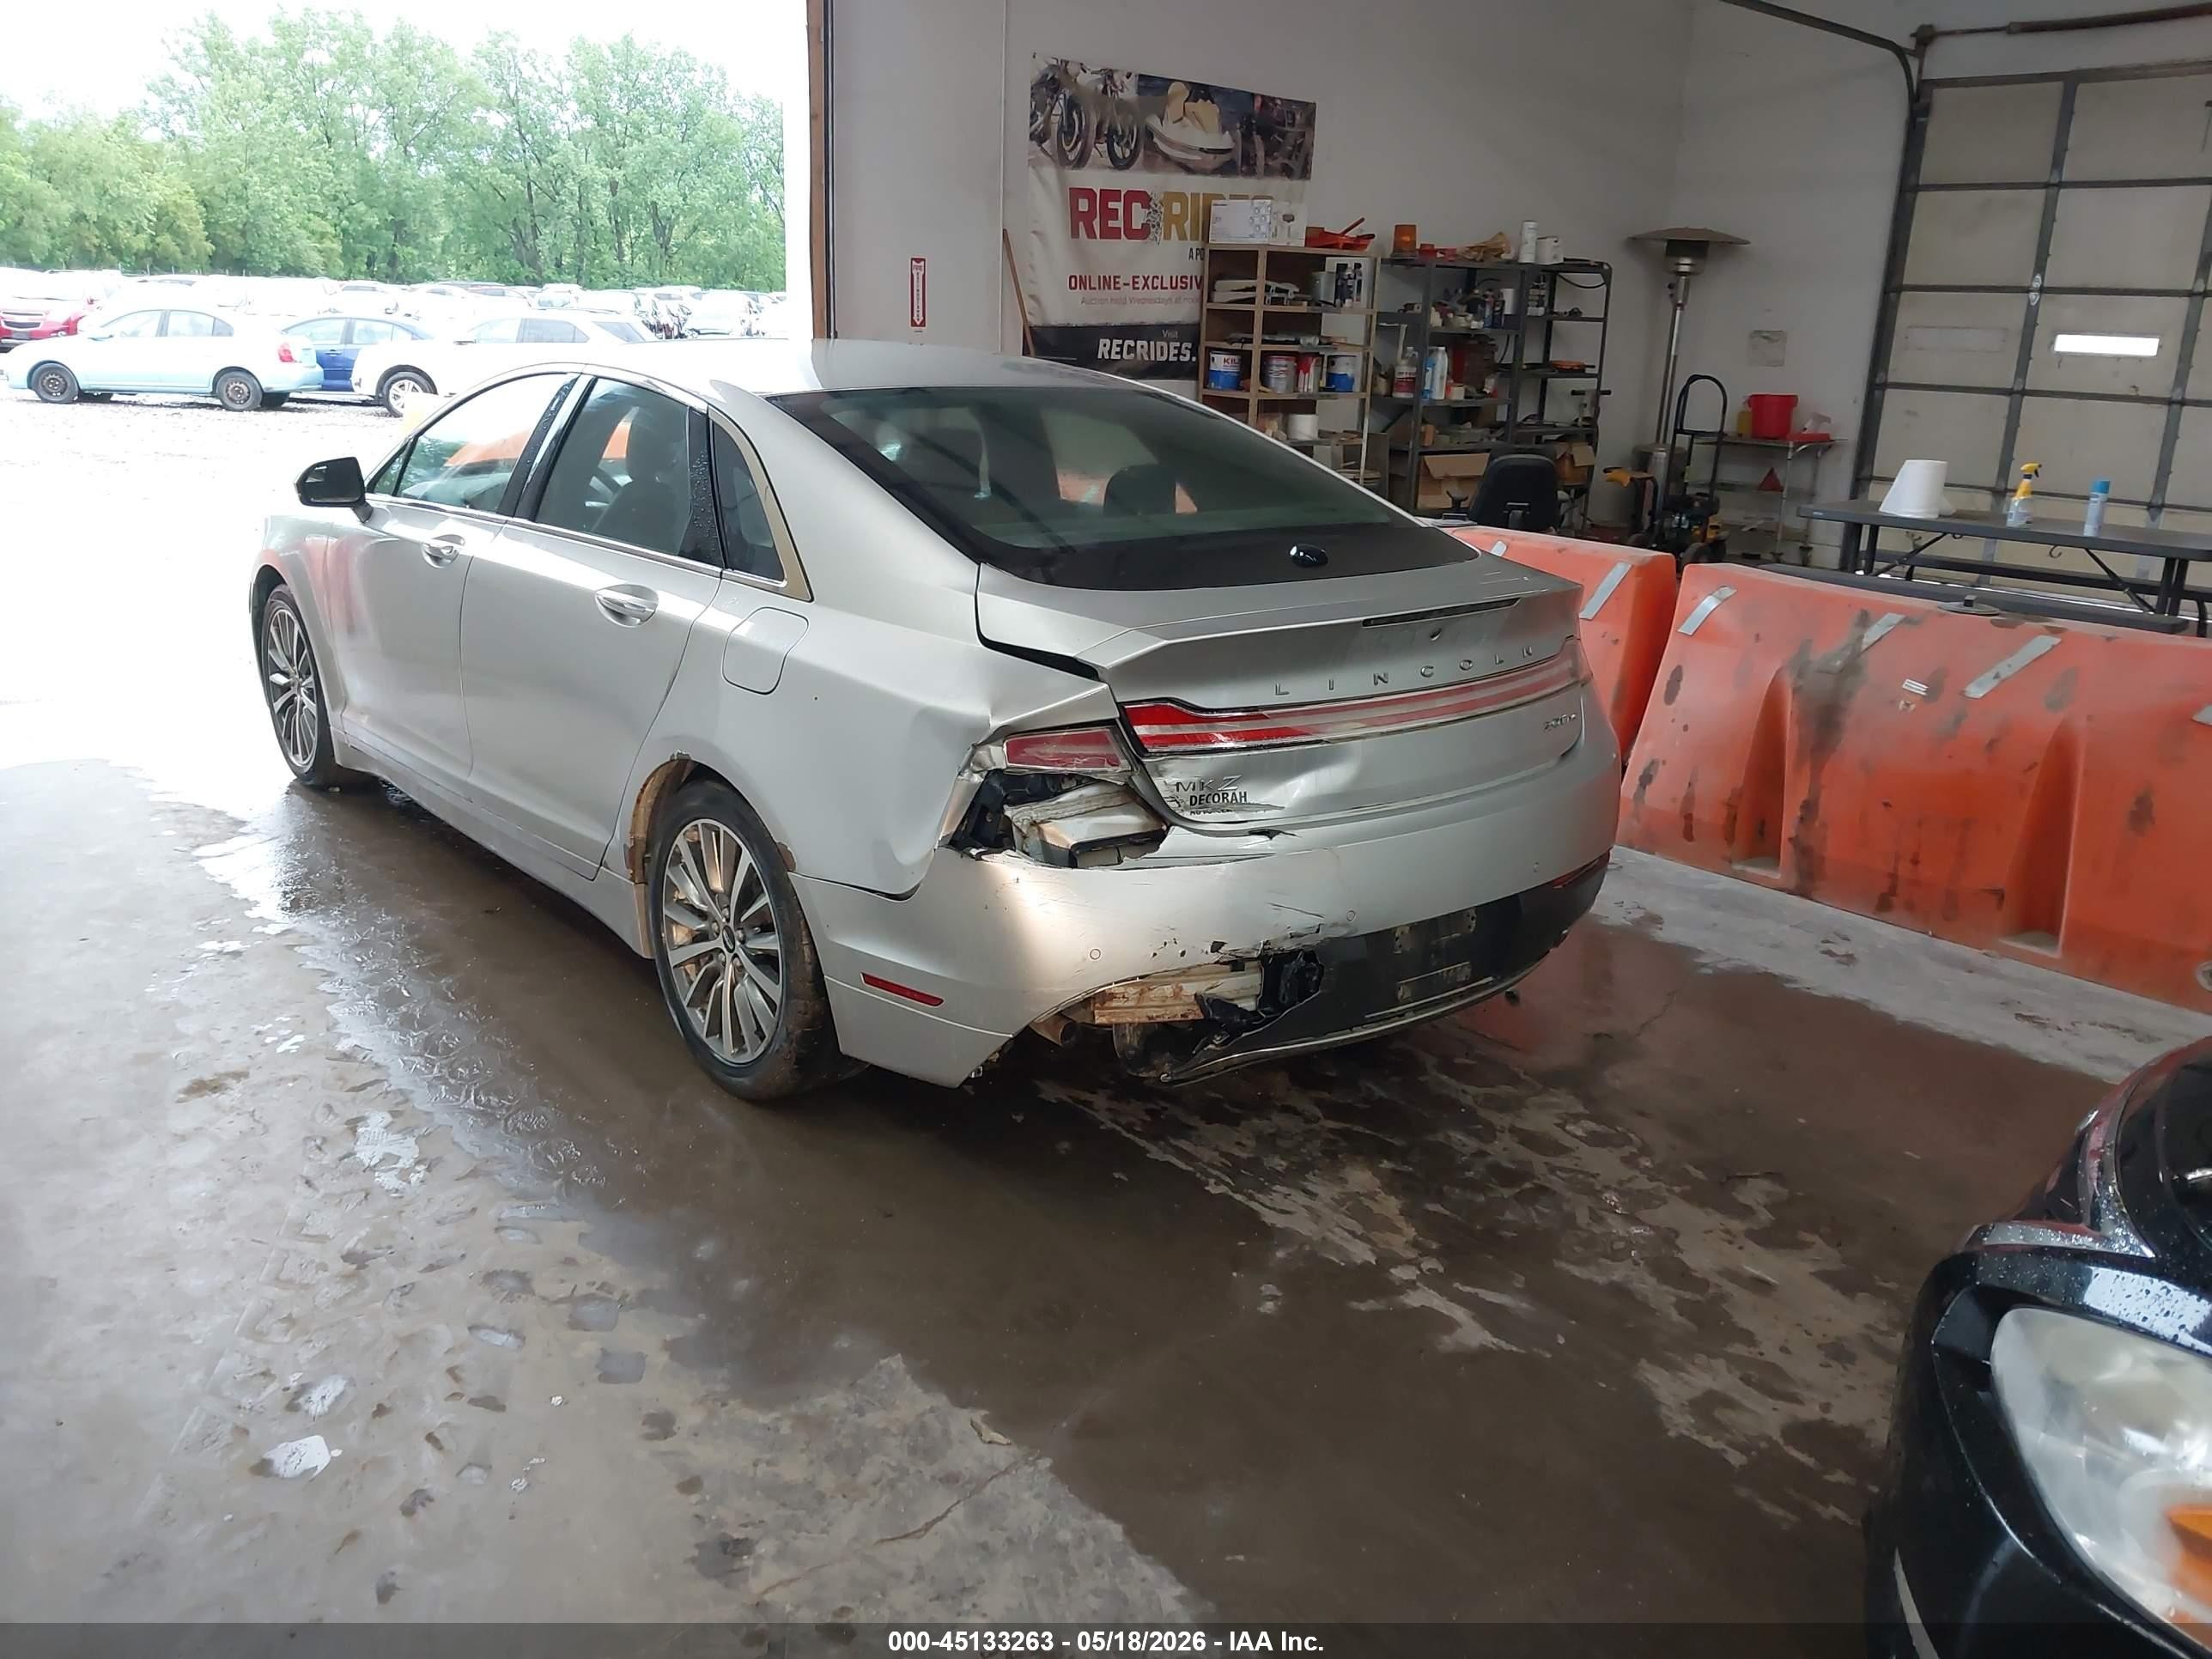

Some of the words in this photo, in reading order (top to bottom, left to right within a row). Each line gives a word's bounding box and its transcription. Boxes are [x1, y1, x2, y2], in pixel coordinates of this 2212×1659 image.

[1069, 187, 1151, 240] REC
[1188, 247, 1194, 261] A
[1162, 329, 1178, 338] Visit
[1097, 338, 1197, 362] RECRIDES.
[1275, 646, 1533, 696] LINCOLN
[1189, 792, 1248, 806] DECORAH
